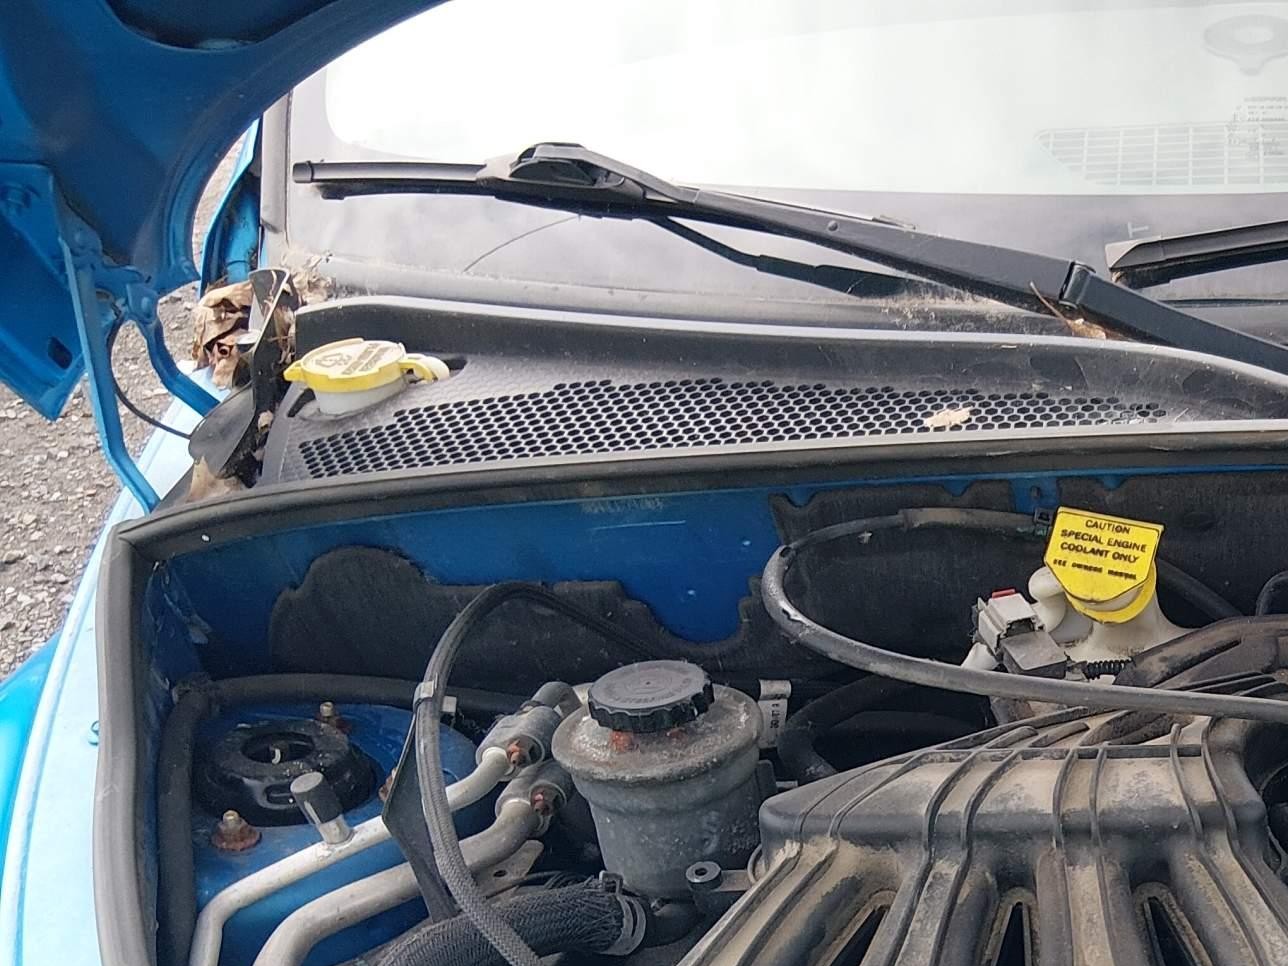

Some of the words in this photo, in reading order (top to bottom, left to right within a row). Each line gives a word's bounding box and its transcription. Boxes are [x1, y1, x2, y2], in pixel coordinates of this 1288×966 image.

[1085, 519, 1131, 534] CAUTION
[1060, 528, 1104, 546] SPECIAL
[1107, 537, 1147, 553] ENGINE
[1060, 541, 1110, 558] COOLANT
[1112, 551, 1140, 564] ONLY
